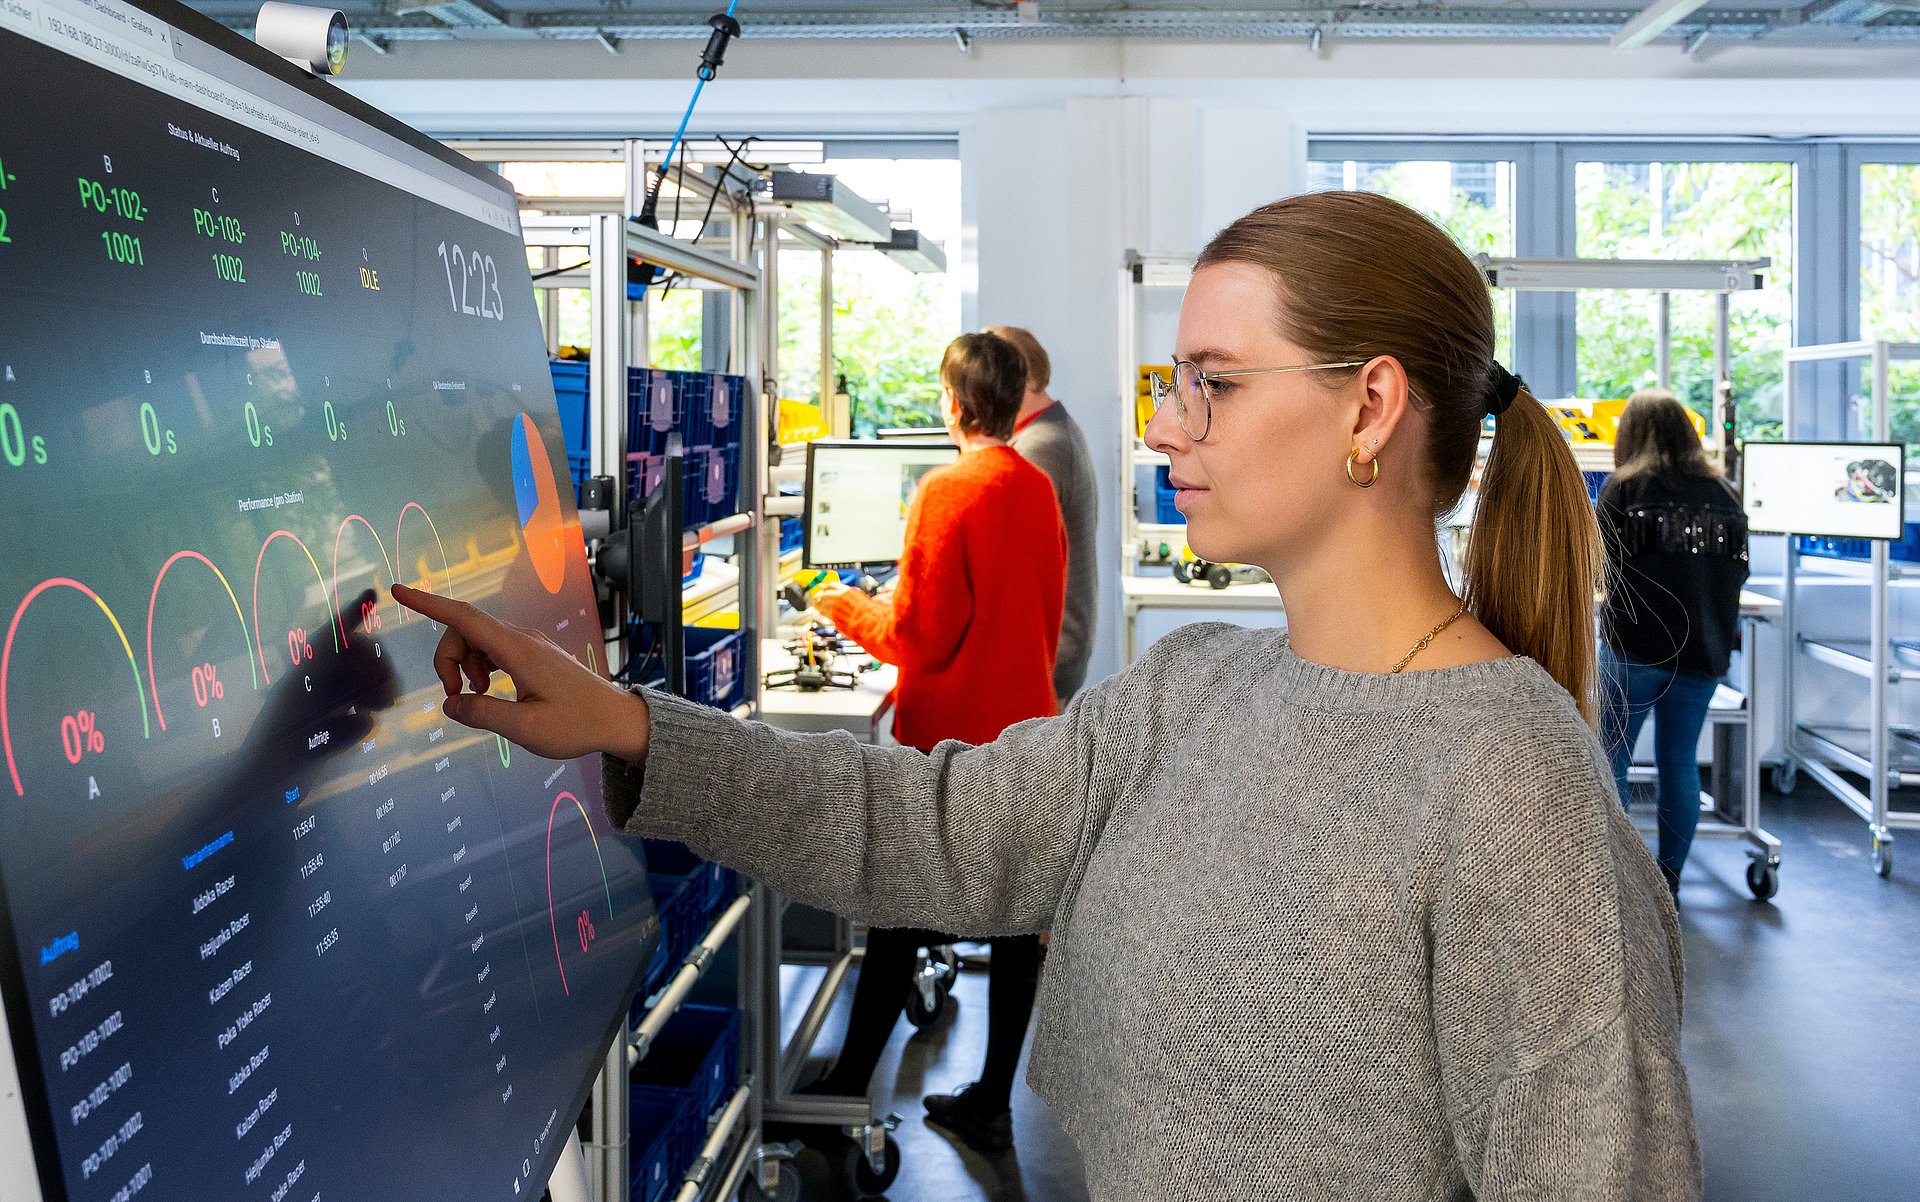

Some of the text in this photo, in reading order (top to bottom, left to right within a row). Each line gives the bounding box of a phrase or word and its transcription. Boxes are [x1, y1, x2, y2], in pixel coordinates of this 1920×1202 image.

[167, 122, 188, 141] Status
[104, 155, 113, 173] B
[78, 177, 148, 222] PO-102-
[212, 188, 219, 203] C
[193, 208, 247, 244] PO-103-
[294, 212, 300, 226] D
[102, 231, 144, 266] 1001
[281, 230, 323, 261] PO-104-
[212, 254, 246, 283] 1002
[359, 267, 381, 291] IDLE
[438, 240, 503, 321] 12:23
[296, 270, 323, 296] 1002
[200, 331, 249, 348] Durchschnittszeit
[5, 365, 16, 382] A
[144, 369, 151, 384] B
[247, 373, 253, 386] C
[325, 376, 330, 387] D
[238, 497, 274, 512] Performance
[361, 600, 382, 634] 0%
[288, 628, 313, 666] 0%
[375, 643, 381, 658] D
[192, 663, 224, 707] 0%
[304, 676, 312, 692] C
[60, 710, 105, 764] 0%
[212, 718, 221, 738] B
[429, 727, 444, 743] Running
[435, 757, 450, 773] Running
[88, 775, 101, 800] A
[285, 785, 301, 805] Start
[441, 786, 456, 804] Running
[293, 815, 316, 841] 11:55:47
[300, 853, 324, 879] 11:55:43
[215, 875, 236, 898] Racer
[230, 913, 250, 936] Racer
[577, 910, 595, 953] 0%
[316, 927, 339, 957] 11:55:35
[209, 960, 252, 1005] Kaizen Racer
[218, 992, 272, 1050] Poka Yoke Racer
[250, 1045, 269, 1072] Racer
[236, 1087, 278, 1140] Kaizen Racer
[273, 1123, 292, 1151] Racer
[287, 1159, 305, 1188] Racer
